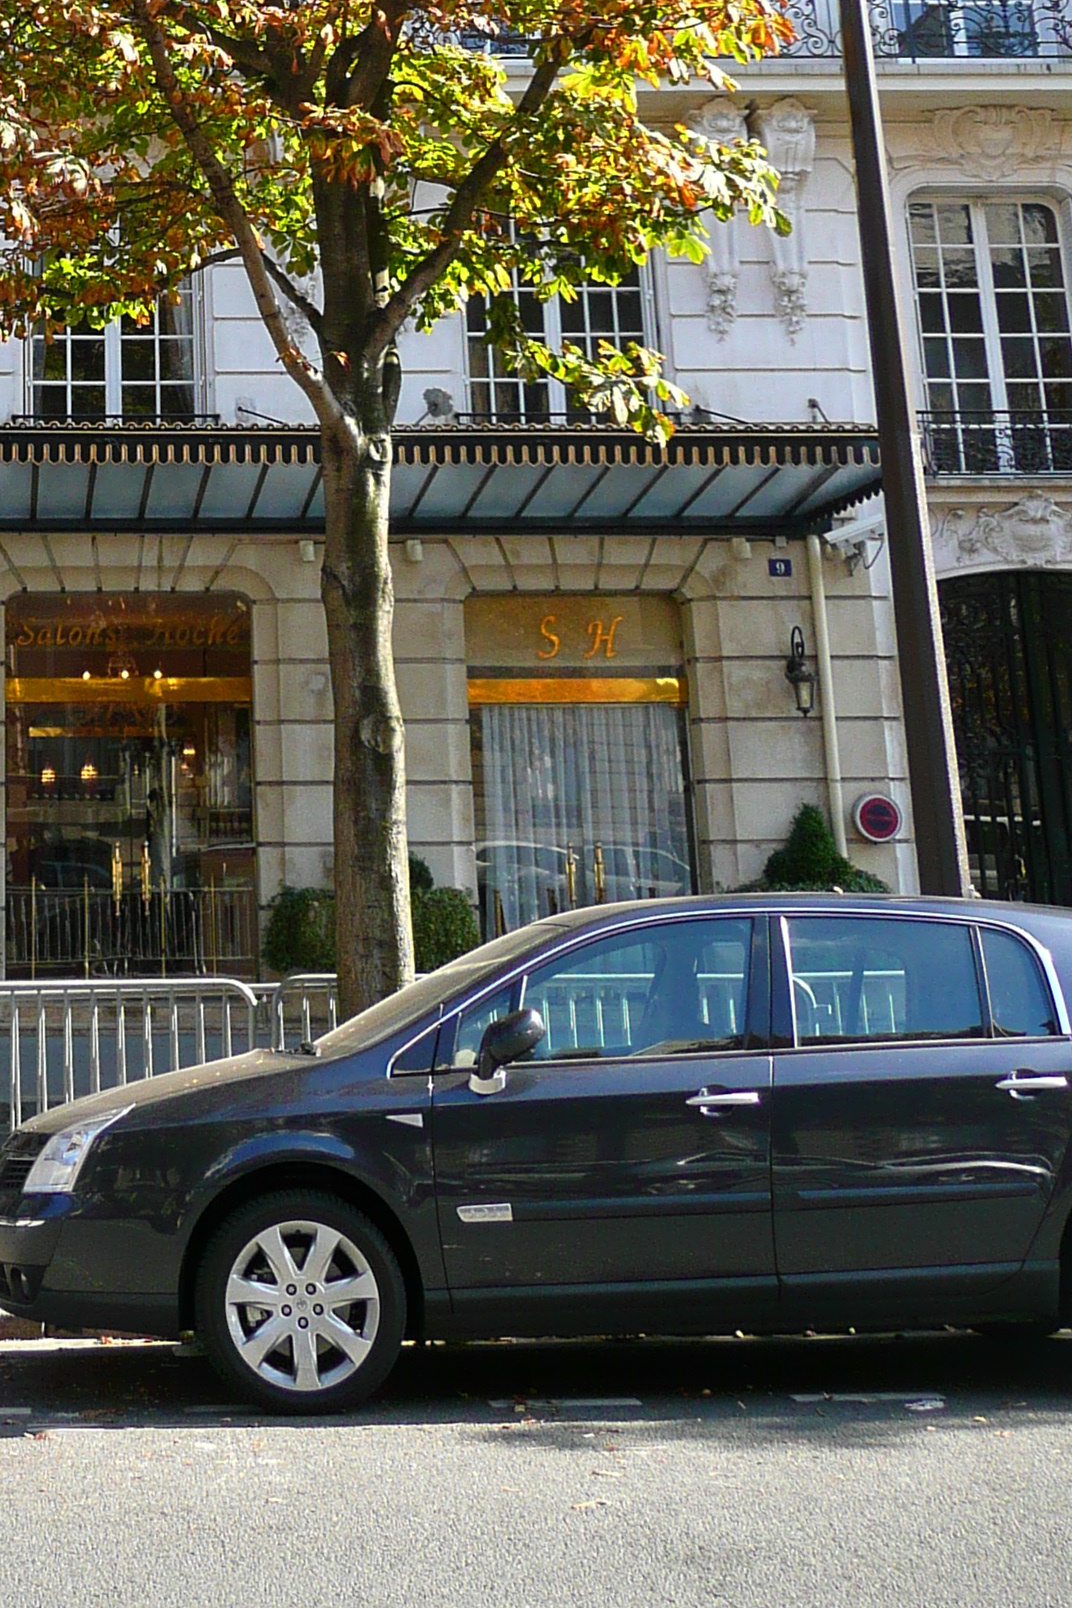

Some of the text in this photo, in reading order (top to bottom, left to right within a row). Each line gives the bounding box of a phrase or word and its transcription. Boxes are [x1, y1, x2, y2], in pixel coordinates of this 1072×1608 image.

[775, 561, 785, 576] 9
[16, 616, 117, 646] Salons
[538, 615, 623, 659] S H
